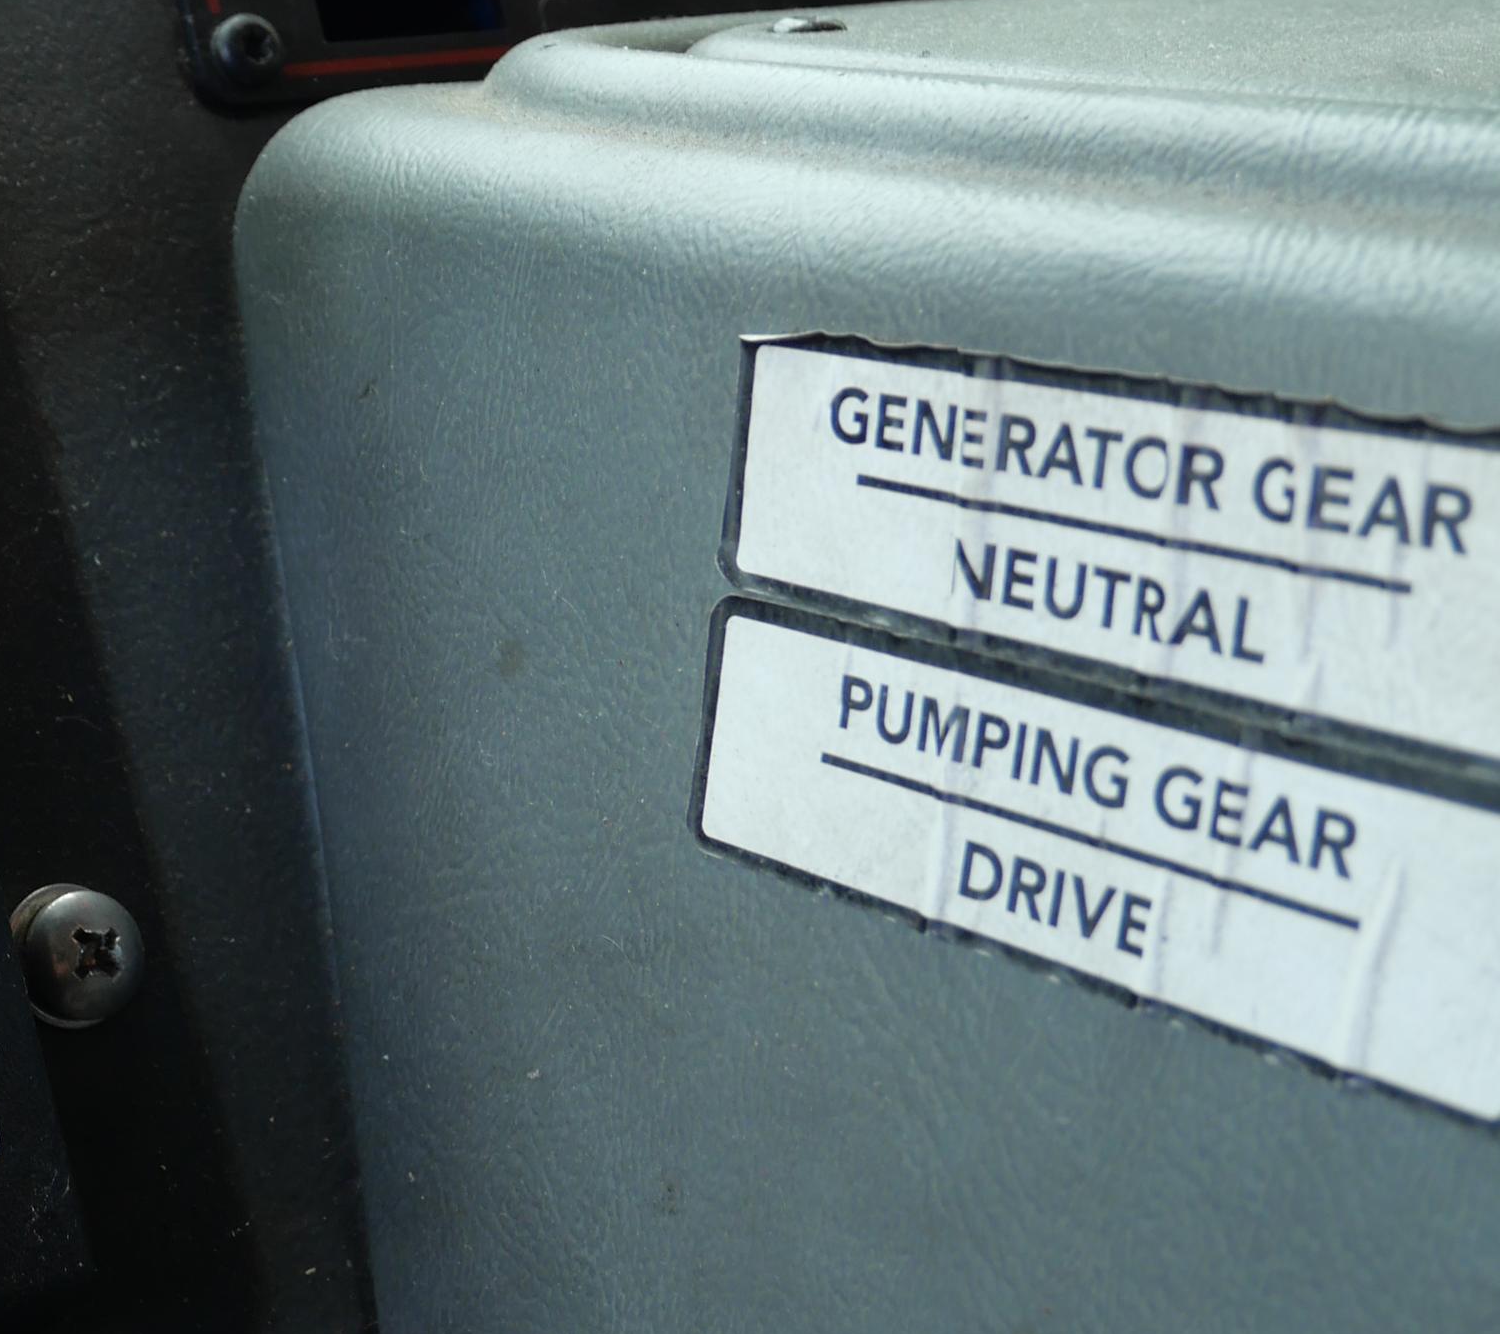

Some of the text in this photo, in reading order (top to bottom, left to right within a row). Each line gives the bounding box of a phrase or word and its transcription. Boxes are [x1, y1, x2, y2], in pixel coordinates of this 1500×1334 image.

[829, 386, 1474, 554] GENERATOR GEAR
[954, 539, 1265, 664] NEUTRAL
[839, 676, 1357, 878] PUMPING GEAR
[959, 842, 1152, 957] DRIVE
